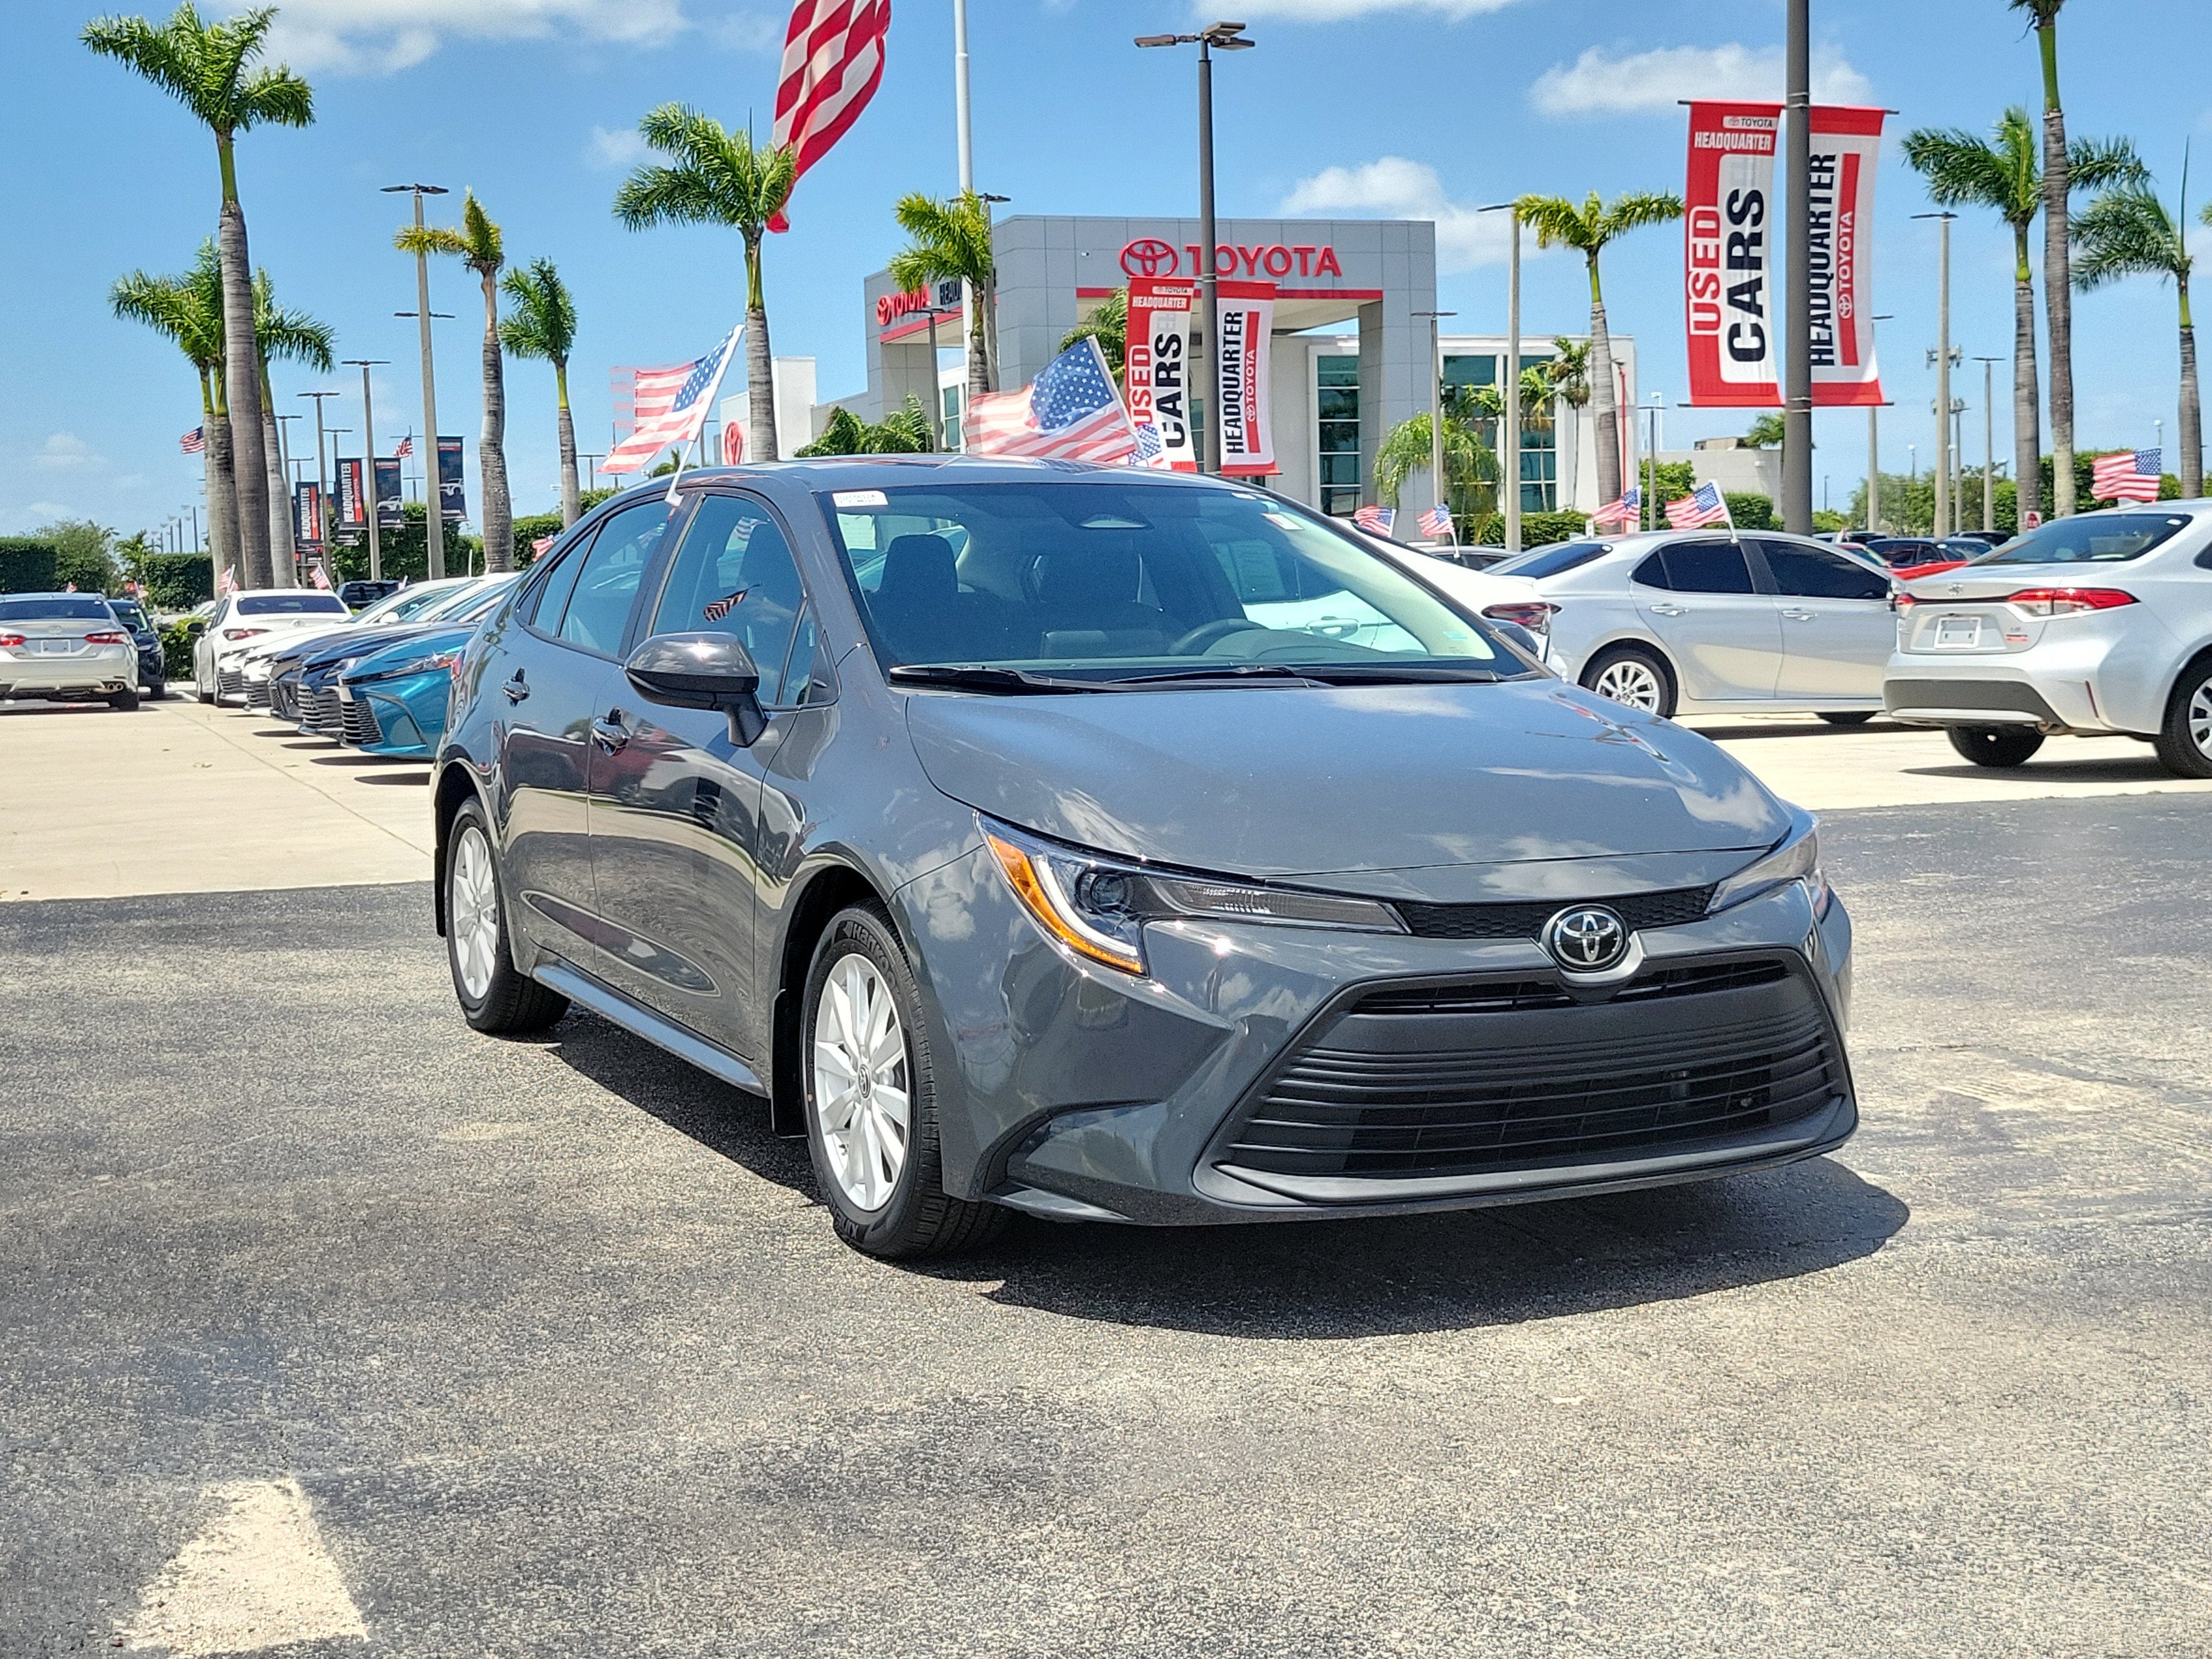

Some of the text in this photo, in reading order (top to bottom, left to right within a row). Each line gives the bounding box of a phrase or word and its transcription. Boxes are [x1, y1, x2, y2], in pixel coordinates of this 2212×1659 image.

[1694, 132, 1771, 151] HEADQUARTER
[1741, 118, 1773, 128] TOYOTA
[1185, 245, 1342, 277] TOYOTA
[1690, 206, 1721, 334] USED
[1726, 189, 1765, 362] CARS
[1810, 154, 1836, 366] HEADQUARTER
[1838, 211, 1854, 292] TOYOTA
[1132, 296, 1187, 309] HEADQUARTER
[1131, 346, 1153, 428] USED
[1154, 333, 1185, 448] CARS
[1222, 312, 1244, 453] HEADQUARTER
[1245, 349, 1255, 403] TOYOTA
